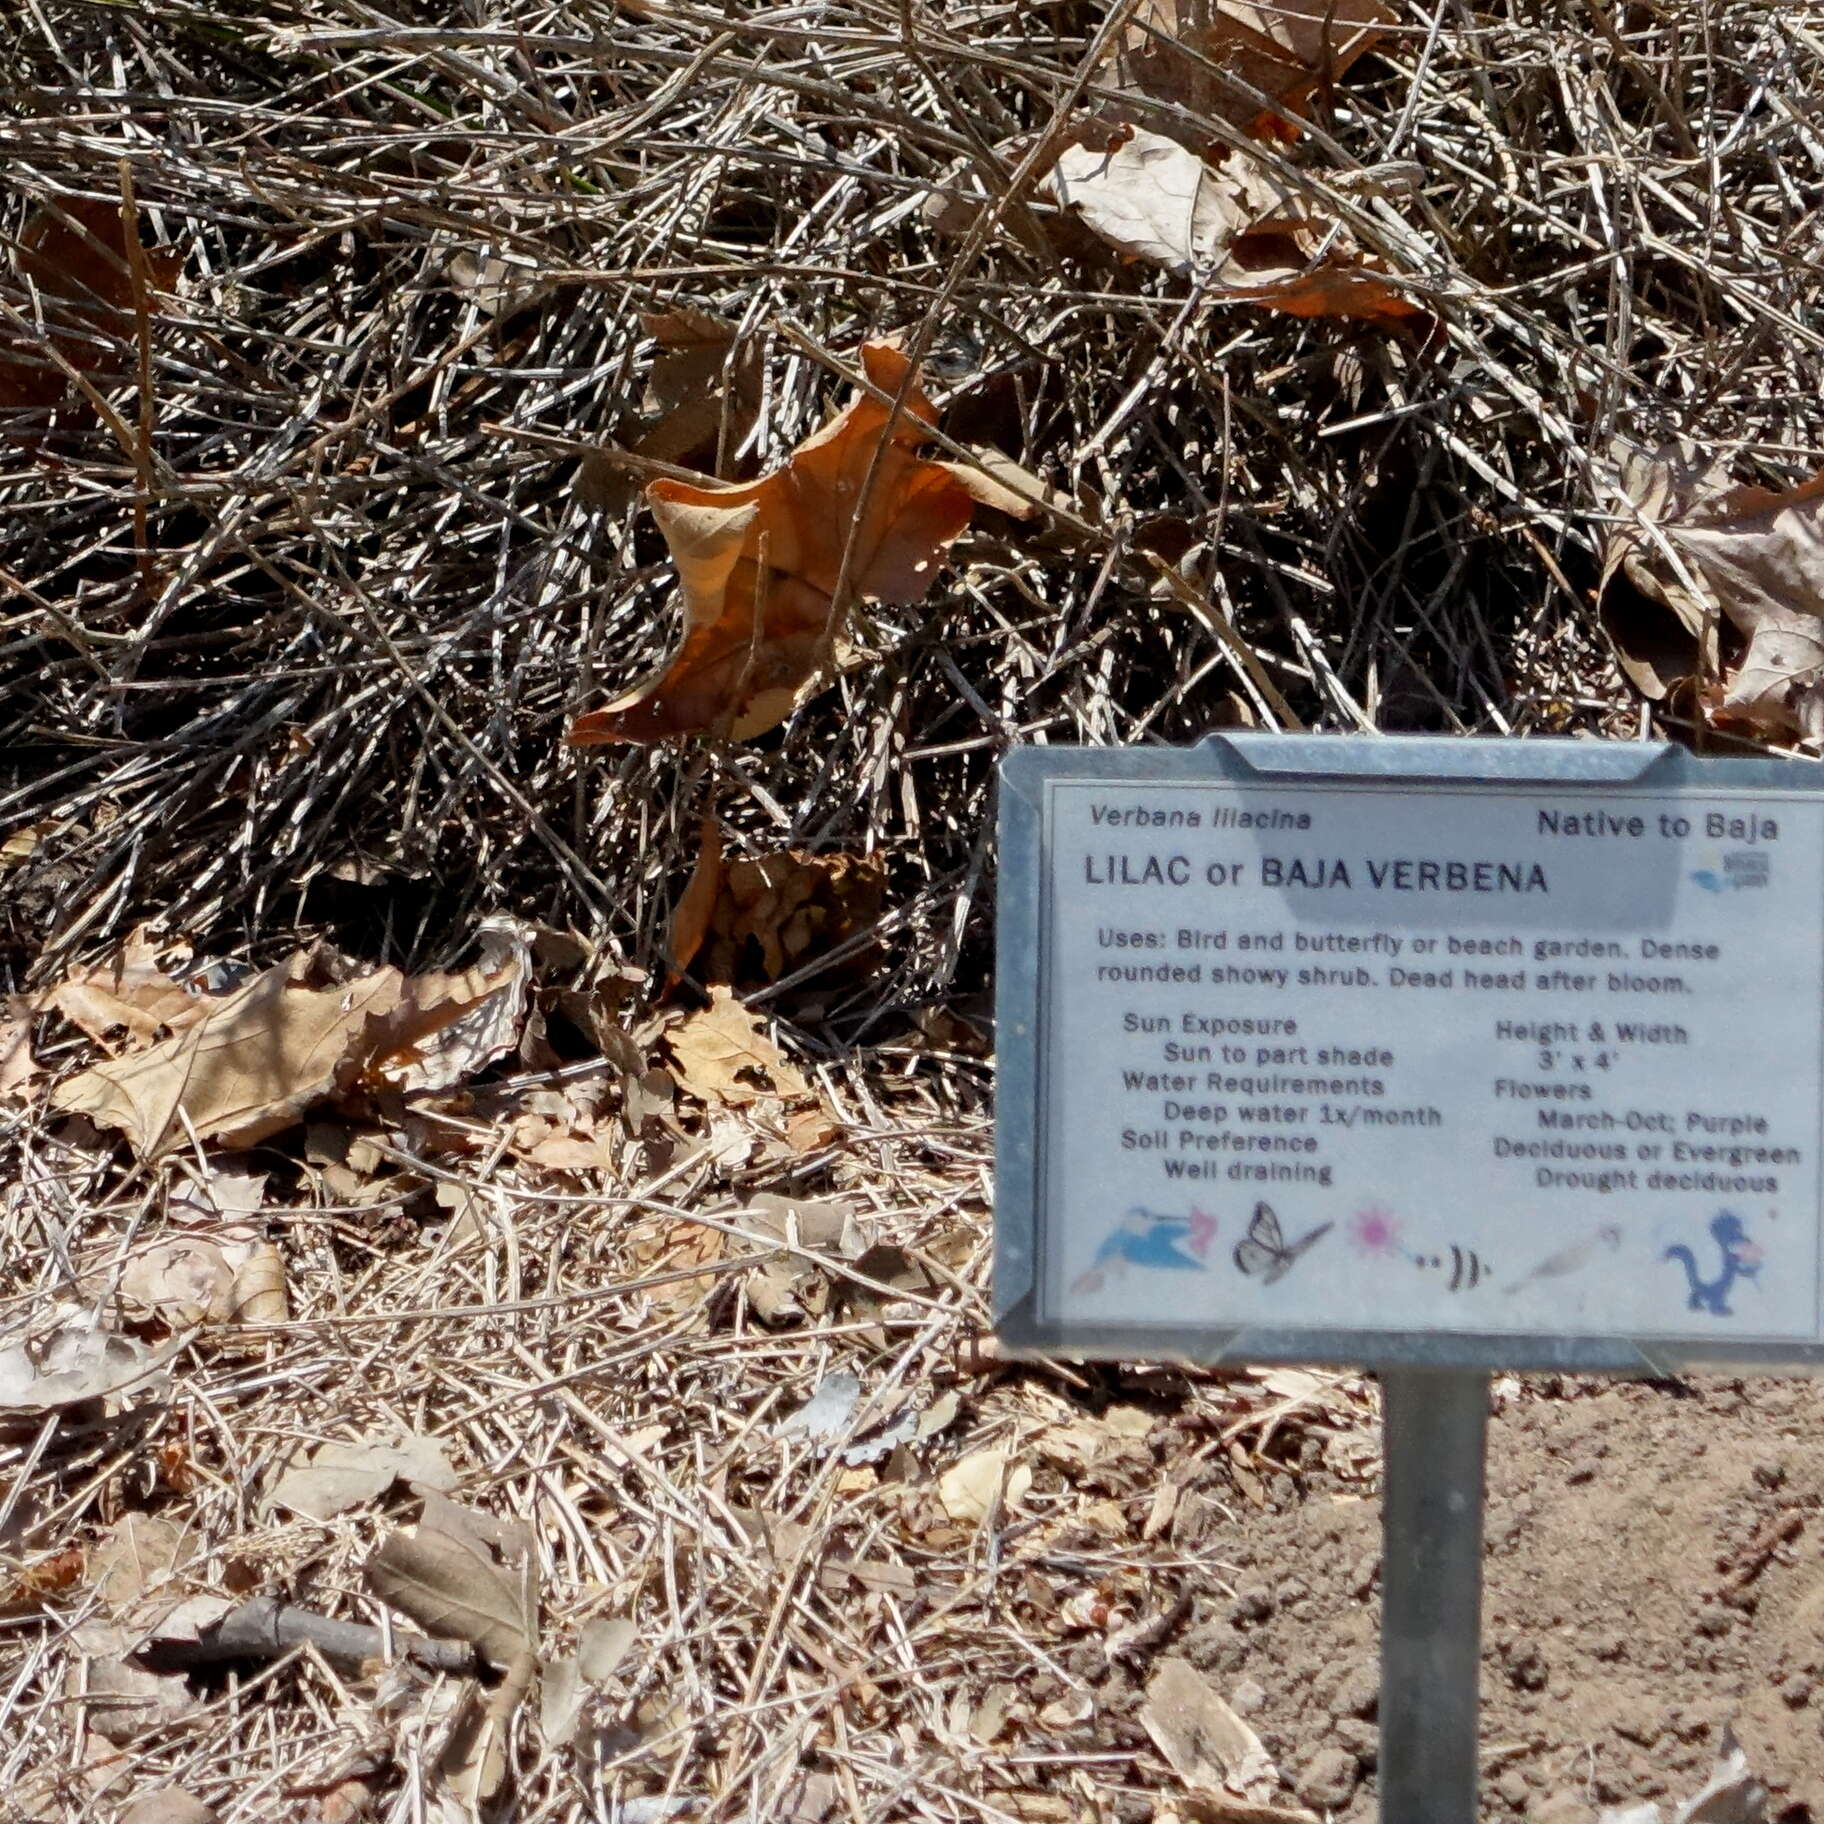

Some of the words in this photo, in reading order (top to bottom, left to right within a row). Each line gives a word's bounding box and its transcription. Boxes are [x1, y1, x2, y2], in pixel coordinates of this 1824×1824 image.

[1213, 807, 1312, 830] lilacina
[1538, 810, 1645, 837] Native
[1659, 812, 1690, 838] to
[1706, 813, 1778, 844] Baja
[1085, 855, 1190, 885] LILAC
[1206, 862, 1244, 887] or
[1262, 858, 1352, 888] BAJA
[1367, 859, 1549, 893] VERBENA
[1098, 928, 1166, 948] Uses:
[1177, 929, 1227, 950] Bird
[1238, 932, 1283, 951] and
[1295, 932, 1402, 957] butterfly
[1413, 937, 1438, 954] or
[1448, 937, 1522, 955] beach
[1534, 937, 1628, 960] garden.
[1642, 939, 1720, 960] Dense
[1097, 964, 1201, 983] rounded
[1212, 965, 1288, 988] showy
[1297, 966, 1379, 987] shrub.
[1389, 968, 1453, 989] Dead
[1464, 970, 1524, 989] head
[1536, 971, 1597, 990] after
[1608, 972, 1693, 994] bloom.
[1123, 1012, 1171, 1033] Sun
[1182, 1014, 1297, 1038] Exposure
[1496, 1021, 1577, 1045] Height
[1589, 1022, 1605, 1042] &
[1615, 1022, 1688, 1044] Width
[1164, 1042, 1212, 1063] Sun
[1224, 1046, 1246, 1064] to
[1256, 1047, 1308, 1067] part
[1317, 1047, 1394, 1067] shade
[1538, 1050, 1561, 1070] 3'
[1572, 1055, 1584, 1070] x
[1123, 1071, 1197, 1092] Water
[1207, 1073, 1385, 1097] Requirements
[1495, 1079, 1592, 1100] Flowers
[1164, 1102, 1228, 1123] Deep
[1238, 1104, 1308, 1124] water
[1320, 1104, 1442, 1127] 1x/month
[1687, 1112, 1769, 1135] Purple
[1121, 1130, 1168, 1150] Soil
[1179, 1131, 1318, 1153] Preference
[1494, 1137, 1627, 1161] Deciduous
[1637, 1143, 1662, 1161] or
[1673, 1141, 1801, 1167] Evergreen
[1164, 1160, 1216, 1179] Well
[1227, 1161, 1333, 1186] draining
[1536, 1167, 1639, 1193] Drought
[1647, 1171, 1778, 1193] deciduous
